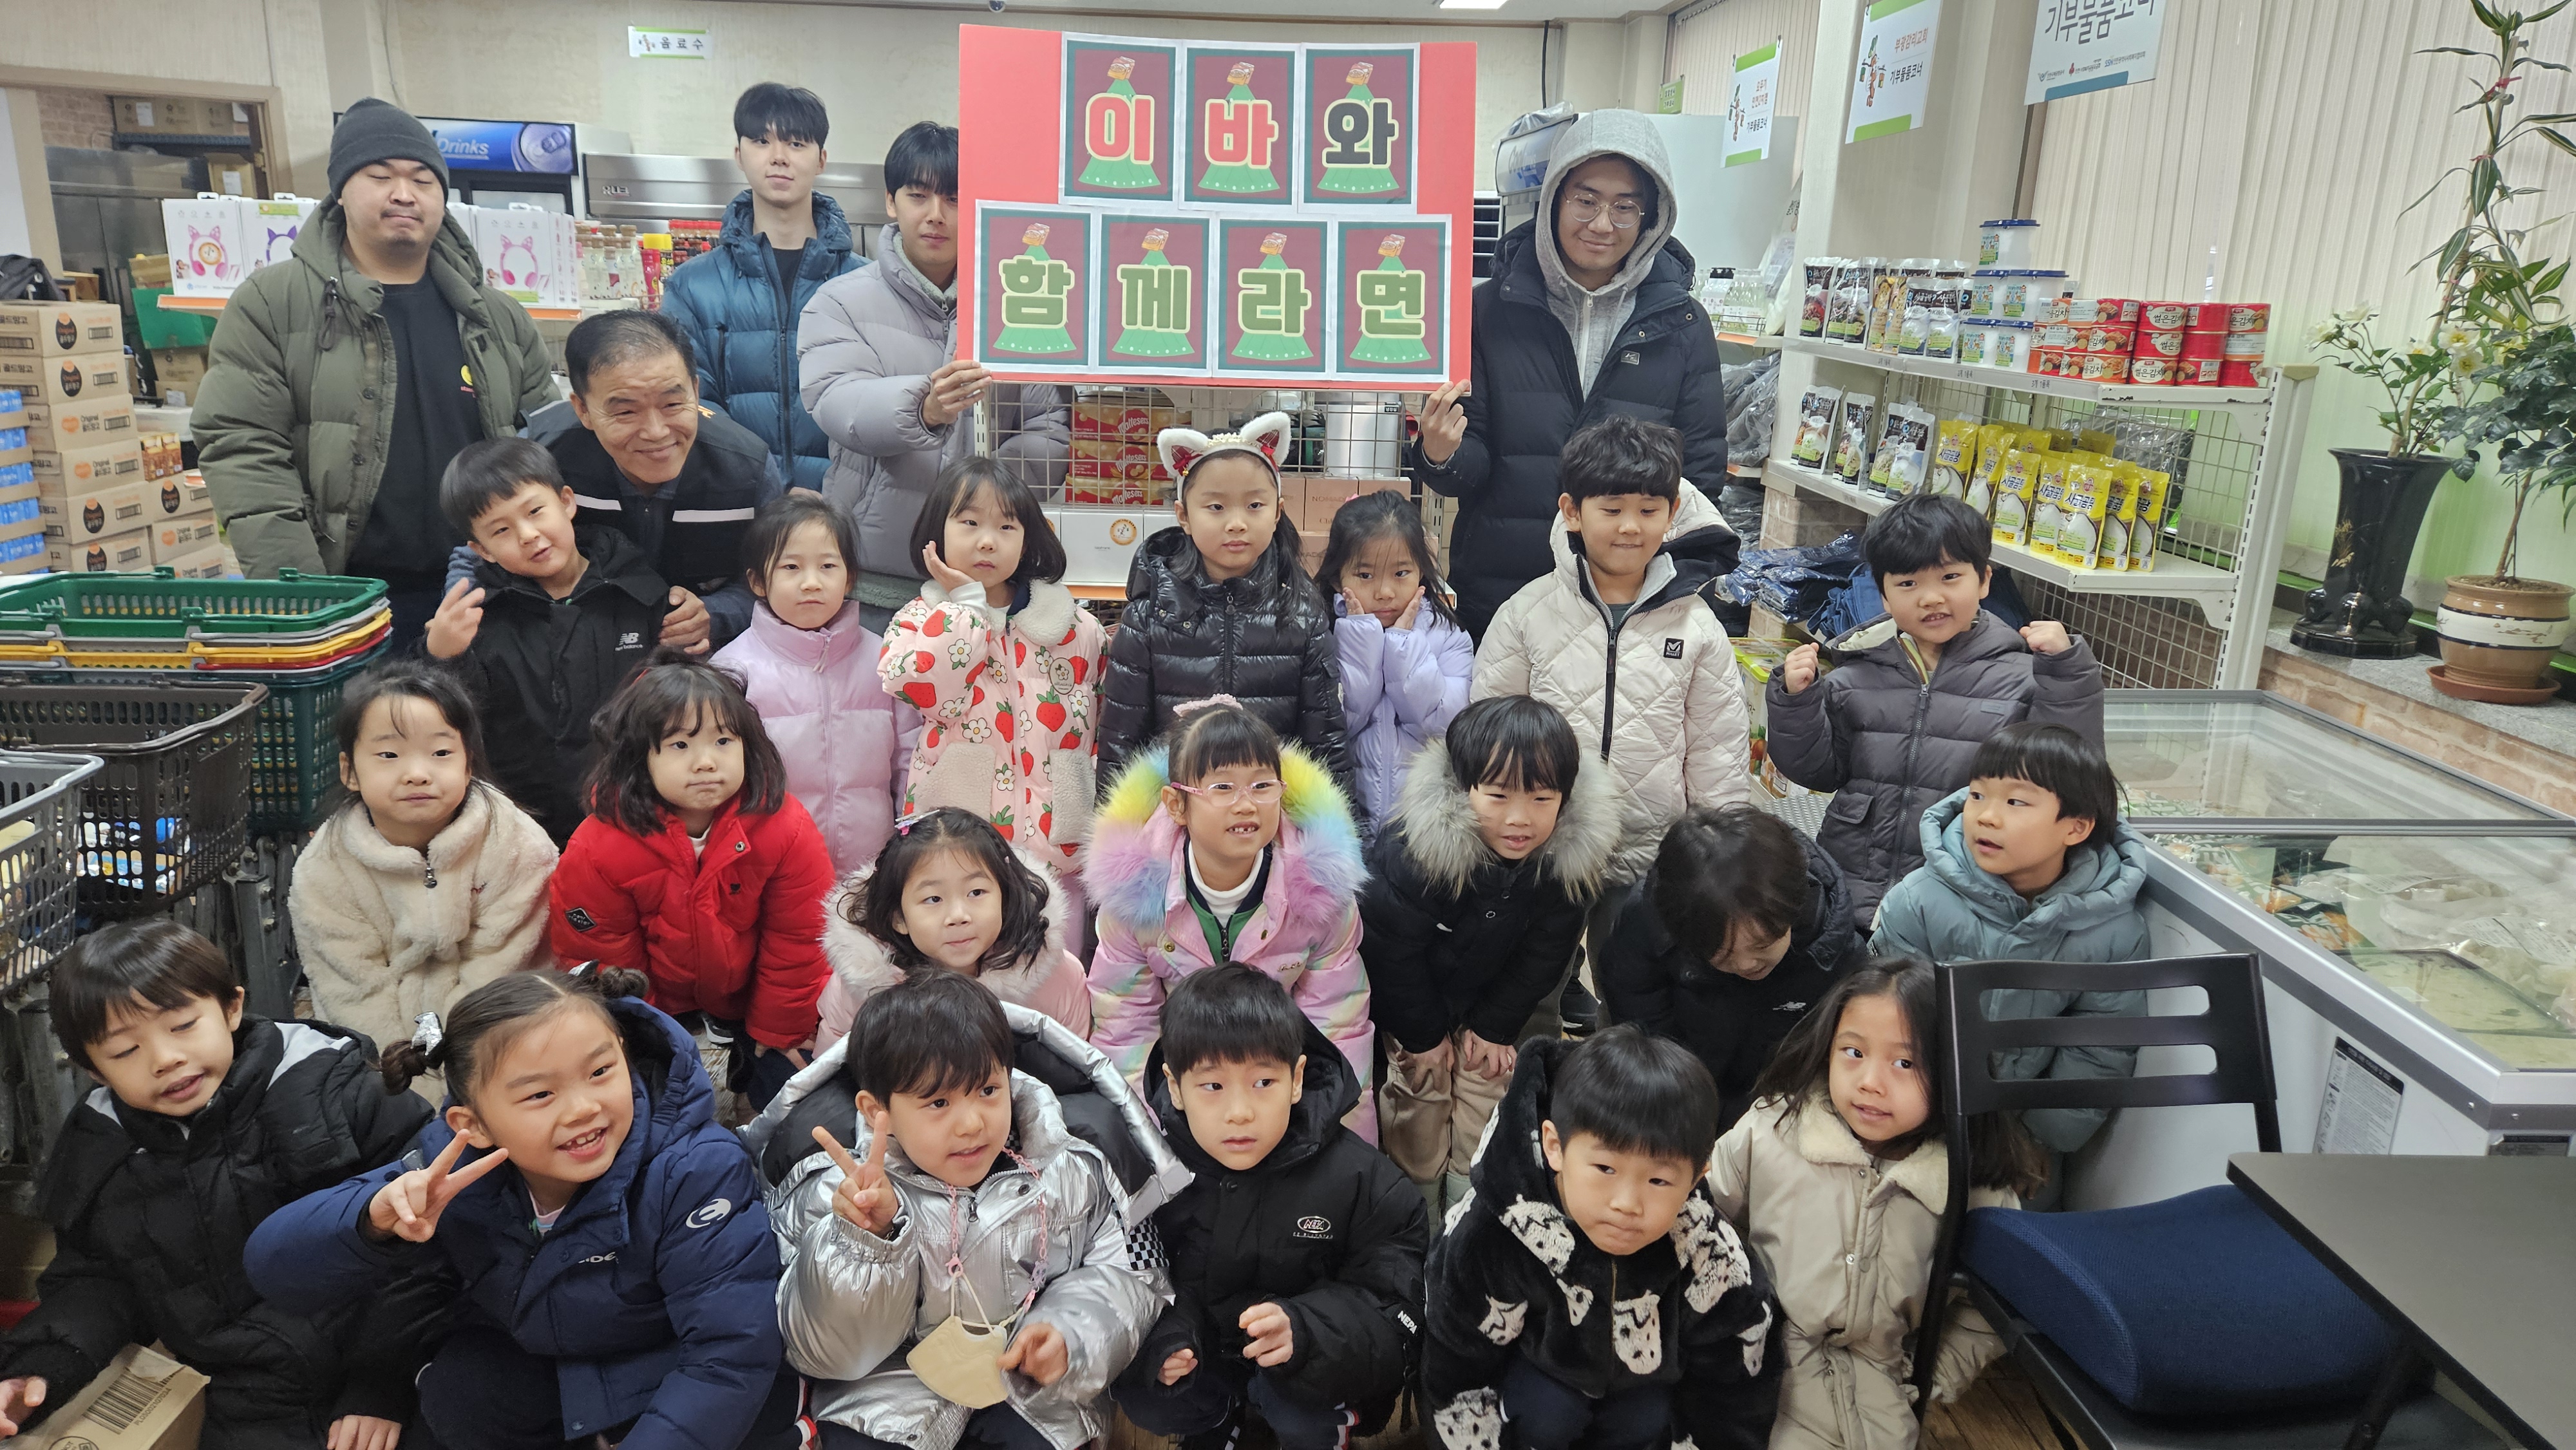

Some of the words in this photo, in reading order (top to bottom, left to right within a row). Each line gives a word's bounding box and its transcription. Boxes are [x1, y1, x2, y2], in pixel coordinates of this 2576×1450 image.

[660, 36, 704, 50] 음료수
[1895, 27, 1929, 53] 부광감리교회
[1890, 61, 1923, 85] 기부물품코너
[437, 137, 489, 155] Drinks
[999, 255, 1425, 339] 함께라면
[2230, 316, 2254, 326] 은김치
[1938, 448, 1961, 463] 사골곰탕
[2001, 475, 2025, 491] 사골곰탕
[2065, 493, 2096, 511] 사골곰탕
[578, 1252, 619, 1264] IDE
[1397, 1310, 1417, 1334] NEPA
